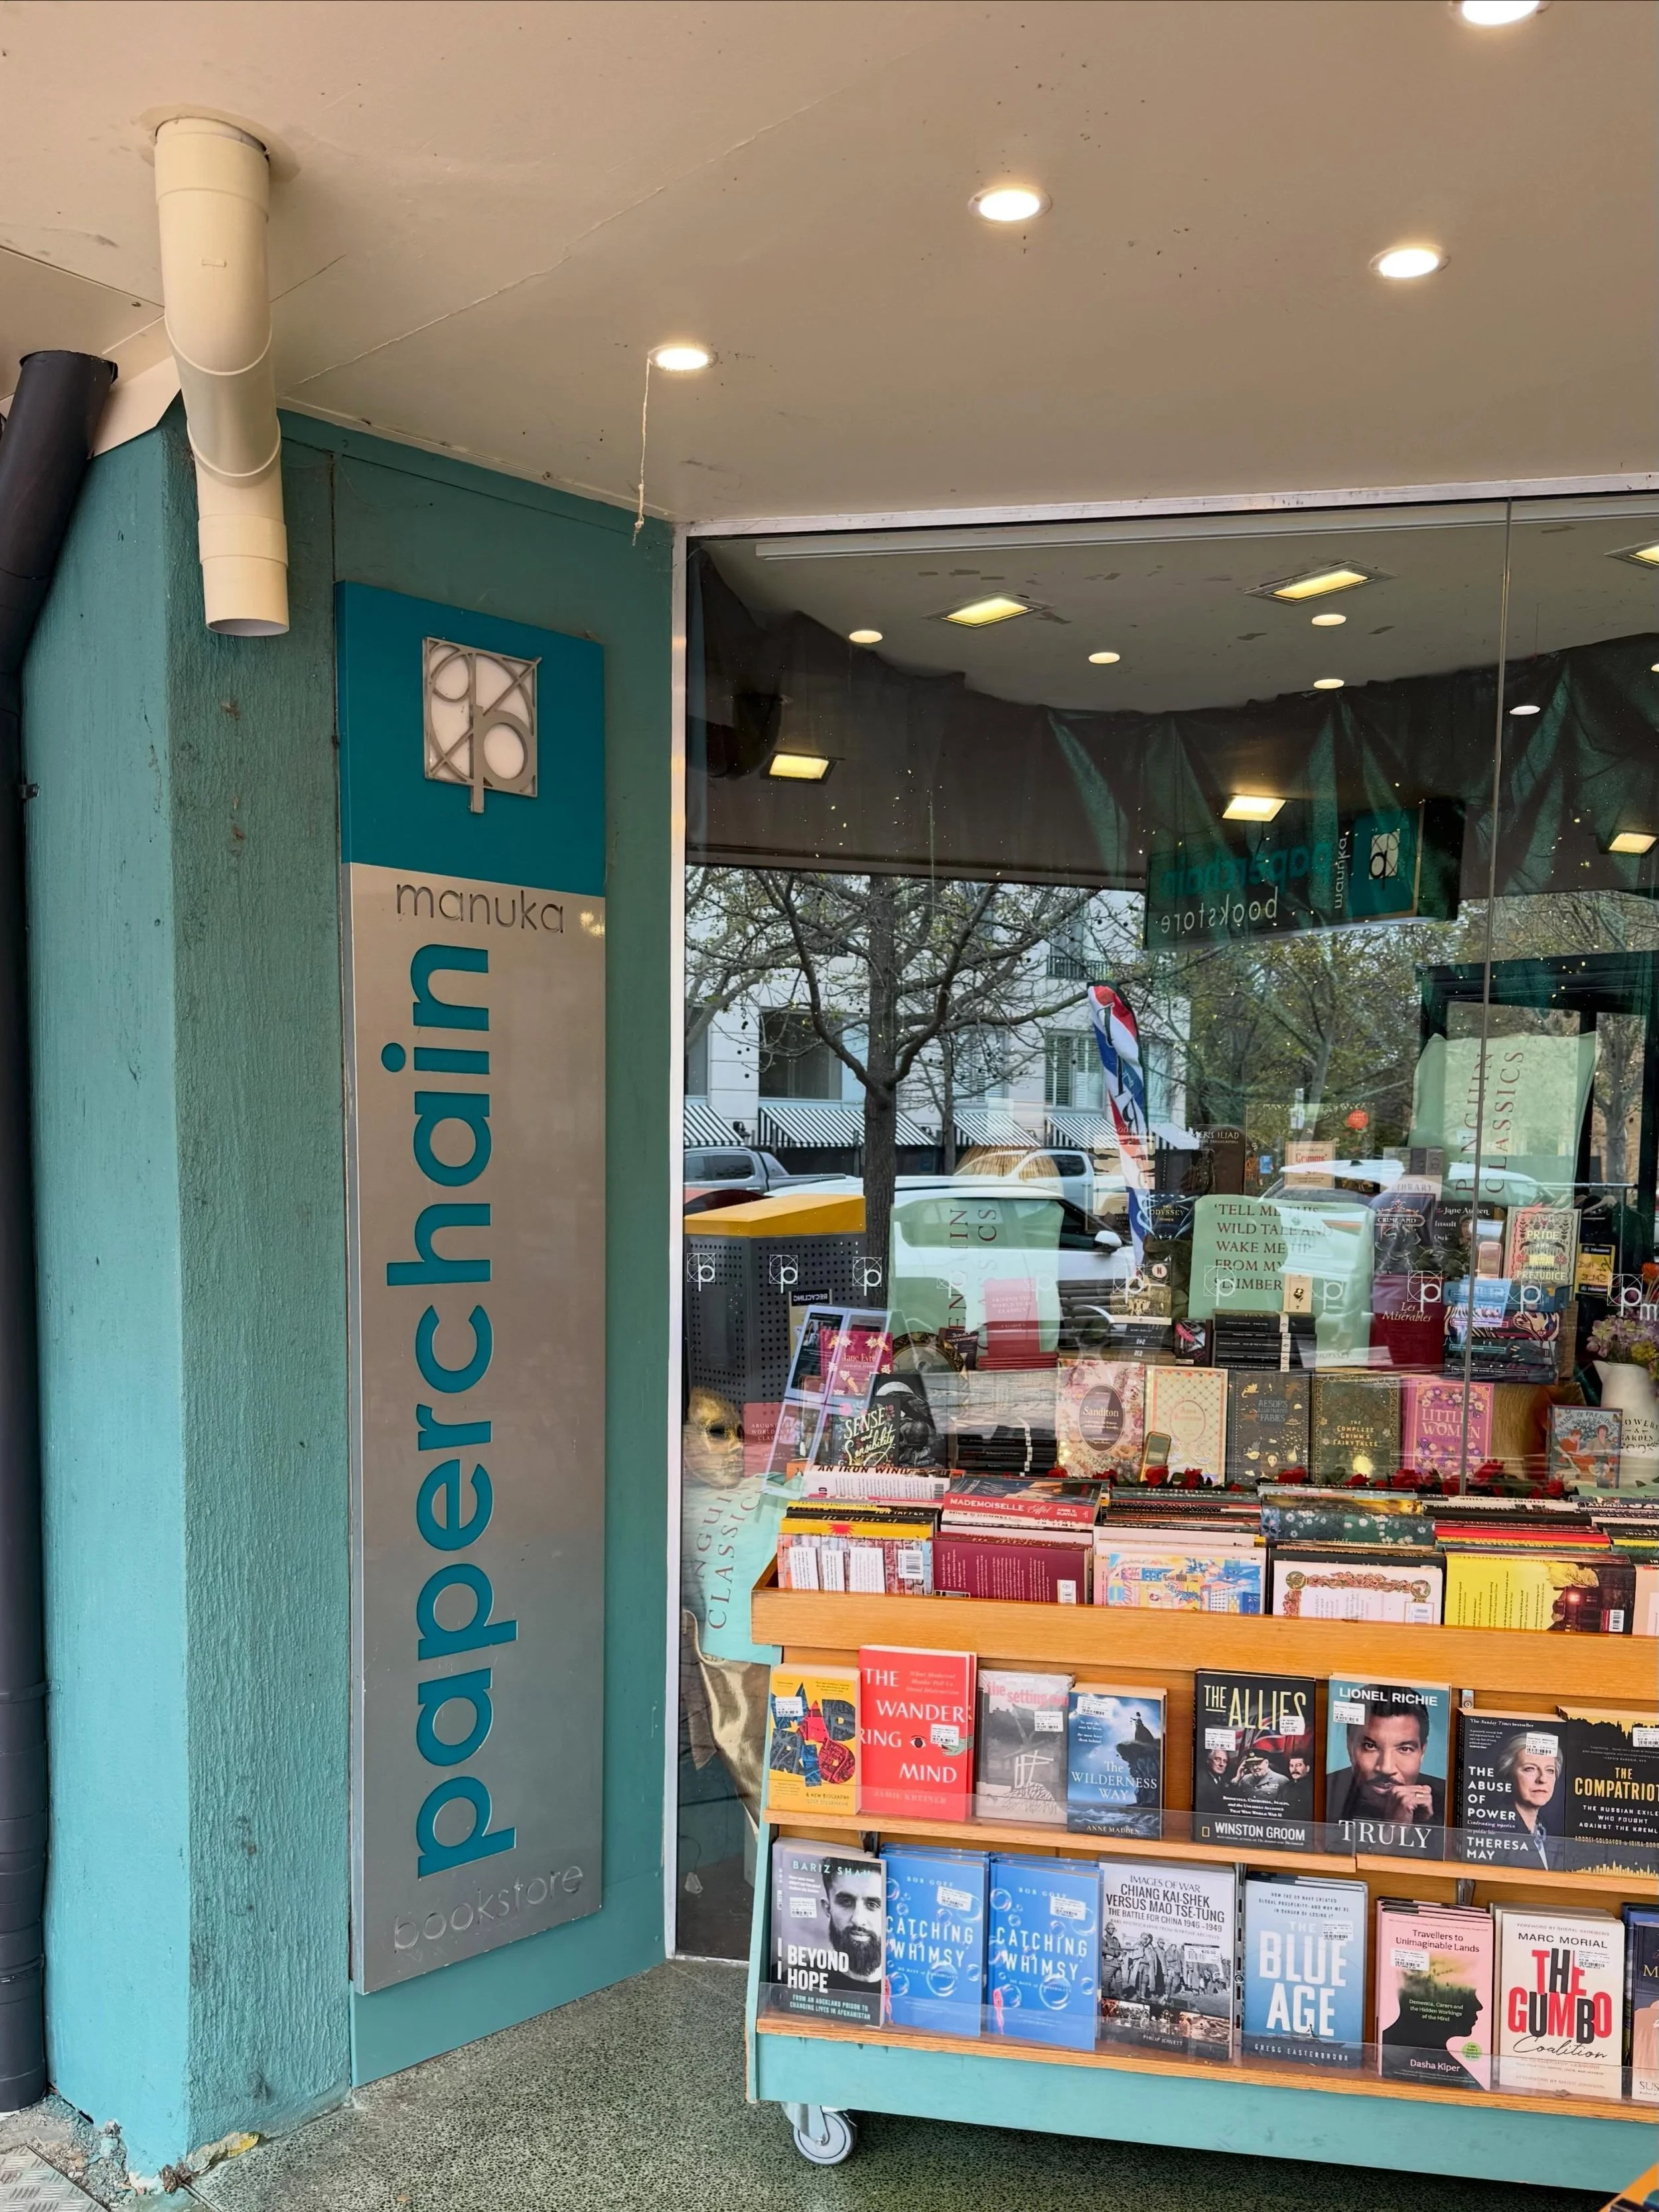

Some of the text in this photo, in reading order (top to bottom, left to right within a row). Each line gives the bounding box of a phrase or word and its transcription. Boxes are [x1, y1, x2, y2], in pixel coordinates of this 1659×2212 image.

[396, 883, 564, 933] manuka
[1485, 1052, 1524, 1193] CLASSICS
[1218, 1222, 1256, 1234] WILD
[1261, 1224, 1301, 1236] TALE
[1527, 1230, 1559, 1240] PRIDE
[1216, 1241, 1285, 1254] WAKE ME
[1216, 1260, 1258, 1271] FROM
[1214, 1278, 1282, 1290] SLUMBER
[1516, 1272, 1567, 1281] PREJUDICE
[1402, 1301, 1417, 1313] Les
[1382, 1311, 1432, 1323] Misérables
[382, 944, 518, 1880] paperchain
[1083, 1406, 1119, 1417] Sanditon
[1422, 1408, 1472, 1424] LITTL
[844, 1407, 885, 1439] SENSE
[1558, 1414, 1573, 1428] PRIDE
[843, 1424, 897, 1466] Sensibility
[950, 1498, 1052, 1514] MADEMOISELLE Eiffel
[863, 1668, 899, 1687] THE
[988, 1681, 1047, 1707] the setting
[1339, 1687, 1438, 1706] LIONEL RICHIE
[876, 1699, 965, 1723] WANDER
[1204, 1685, 1227, 1708] THE
[1228, 1688, 1306, 1731] ALLIES
[861, 1728, 902, 1748] RING
[899, 1763, 957, 1783] MIND
[1104, 1761, 1123, 1773] The
[1468, 1766, 1494, 1777] THE
[1615, 1767, 1633, 1779] THE
[1071, 1771, 1157, 1789] WILDERNESS
[1467, 1780, 1512, 1793] ABUSE
[1099, 1787, 1128, 1801] WAY
[1467, 1794, 1486, 1804] OF
[1467, 1808, 1516, 1821] POWER
[1109, 1826, 1139, 1835] MADDEN
[1214, 1822, 1263, 1837] WINSTON
[1266, 1826, 1305, 1841] GROOM
[1338, 1820, 1432, 1848] TRULY
[1467, 1836, 1529, 1851] THERESA
[1467, 1849, 1494, 1860] MAY
[793, 1861, 831, 1873] BARIZ
[1130, 1875, 1200, 1892] IMAGES OF WAR
[1121, 1883, 1210, 1908] CHIANG KAI-SHEK
[394, 1865, 583, 1953] bookstore
[1106, 1893, 1224, 1923] VERSUS MAO TSE-TUNG
[1122, 1910, 1145, 1920] BATTLE
[1147, 1913, 1159, 1923] FOR
[1161, 1917, 1182, 1926] CHINA
[1184, 1919, 1200, 1929] 1946
[1289, 1921, 1316, 1933] THE
[886, 1915, 974, 1945] CATCHING
[1413, 1929, 1453, 1941] Travellers
[997, 1927, 1087, 1957] CATCHING
[1396, 1937, 1480, 1953] Unimaginable Lands
[1518, 1933, 1608, 1949] MARC MORIAL
[787, 1945, 849, 1972] BEYOND
[893, 1941, 964, 1968] WHIMSY
[1260, 1930, 1346, 1987] BLUE
[1005, 1953, 1078, 1981] WHIMSY
[1532, 1948, 1587, 1997] THE
[787, 1968, 828, 1994] HOPE
[790, 2002, 814, 2010] CHANGING
[816, 2005, 830, 2014] LIVES
[837, 2009, 871, 2020] AFGHANISTAN
[816, 1998, 841, 2007] AUCKLAND
[842, 2001, 860, 2010] PRISON
[1266, 1982, 1335, 2037] AGE
[1409, 1999, 1435, 2008] Dementia,
[1508, 1986, 1612, 2044] GUMBO
[1254, 2043, 1348, 2061] GREGG EASTERBROOK
[1513, 2035, 1608, 2058] Coalition
[1410, 2059, 1461, 2073] Dasha Kiper
